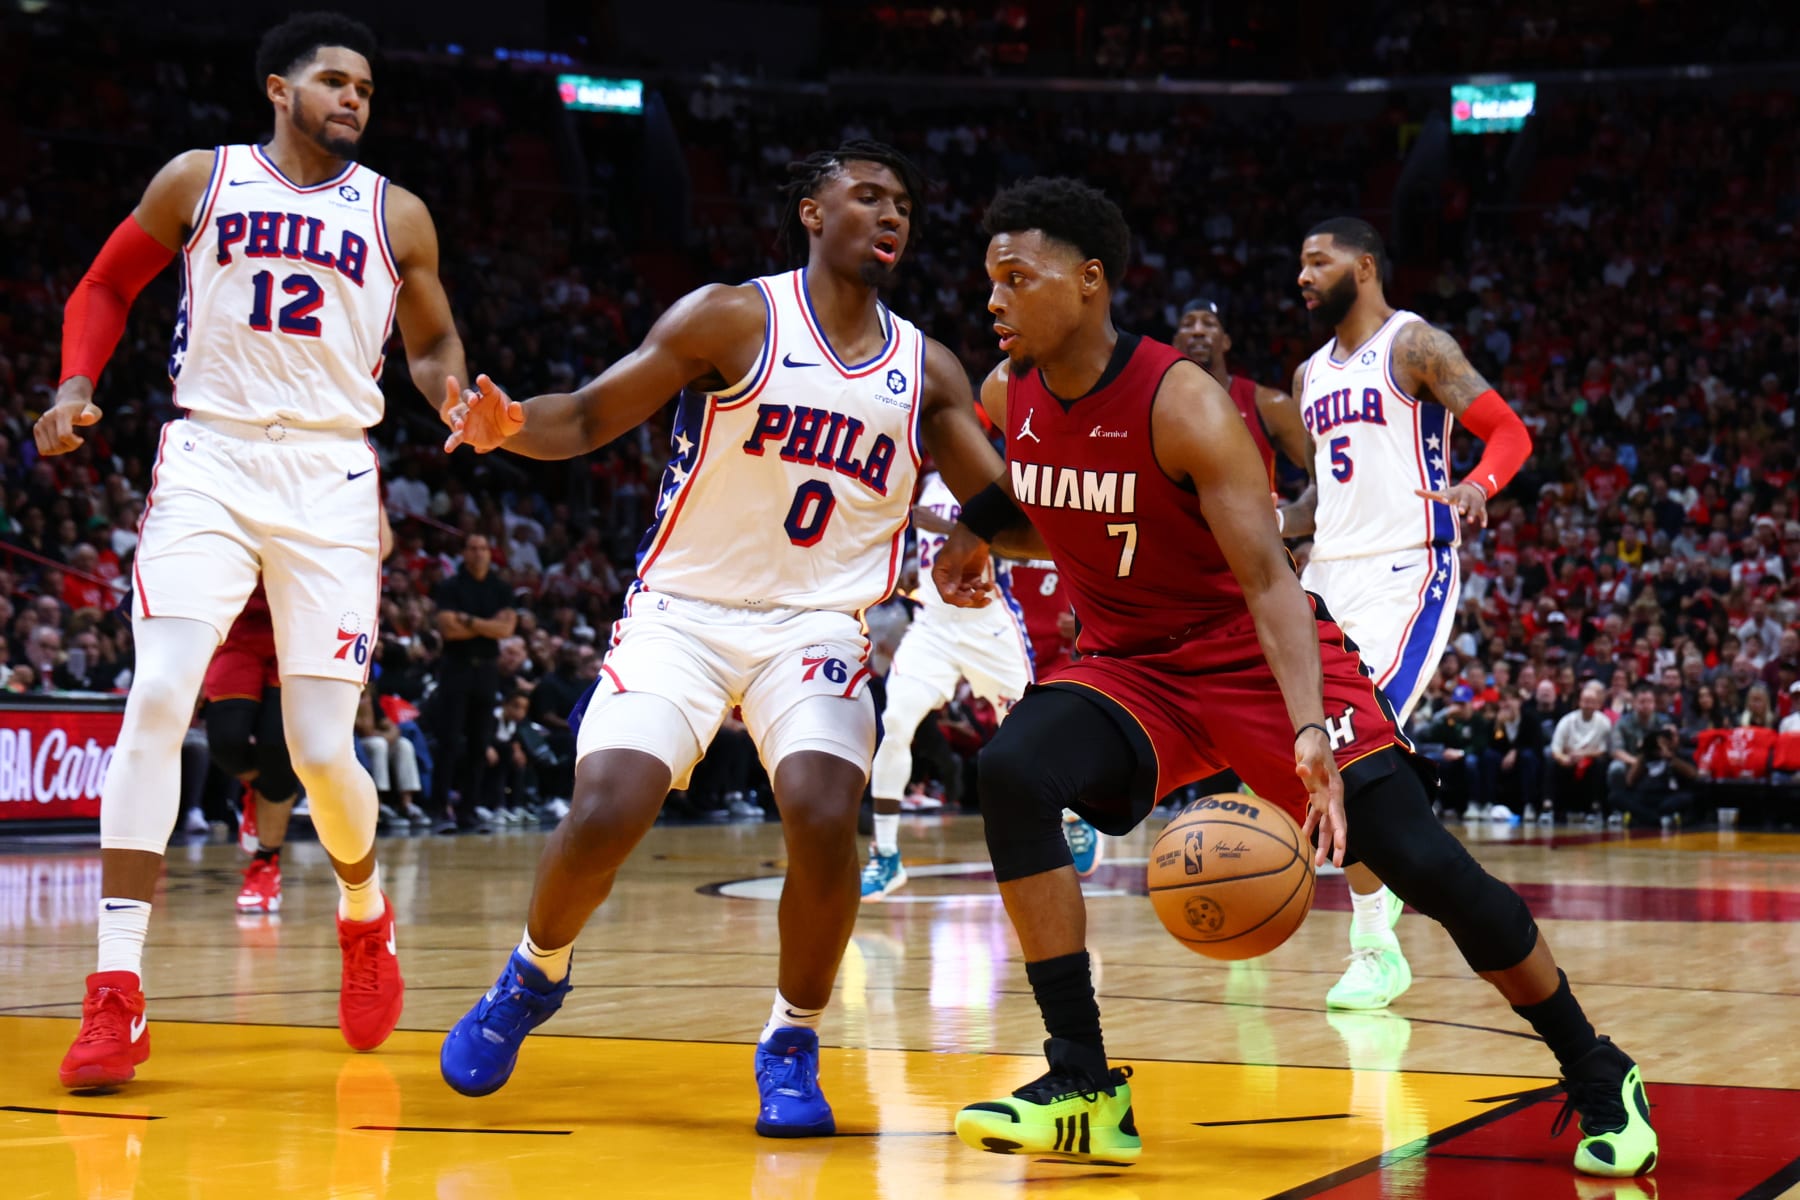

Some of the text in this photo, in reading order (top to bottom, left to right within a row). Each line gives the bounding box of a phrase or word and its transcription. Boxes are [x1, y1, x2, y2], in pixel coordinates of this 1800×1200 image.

[216, 211, 368, 288] PHILA
[249, 270, 325, 337] 12
[1097, 430, 1128, 438] Carnival
[1304, 387, 1387, 435] PHILA
[743, 403, 897, 497] PHILA
[1330, 436, 1354, 483] 5
[1010, 460, 1137, 514] MIAMI
[784, 479, 836, 548] 0
[1106, 523, 1138, 578] 7
[1039, 572, 1059, 596] 8
[334, 627, 368, 665] 76
[801, 656, 847, 684] 76
[1175, 797, 1259, 819] ilson
